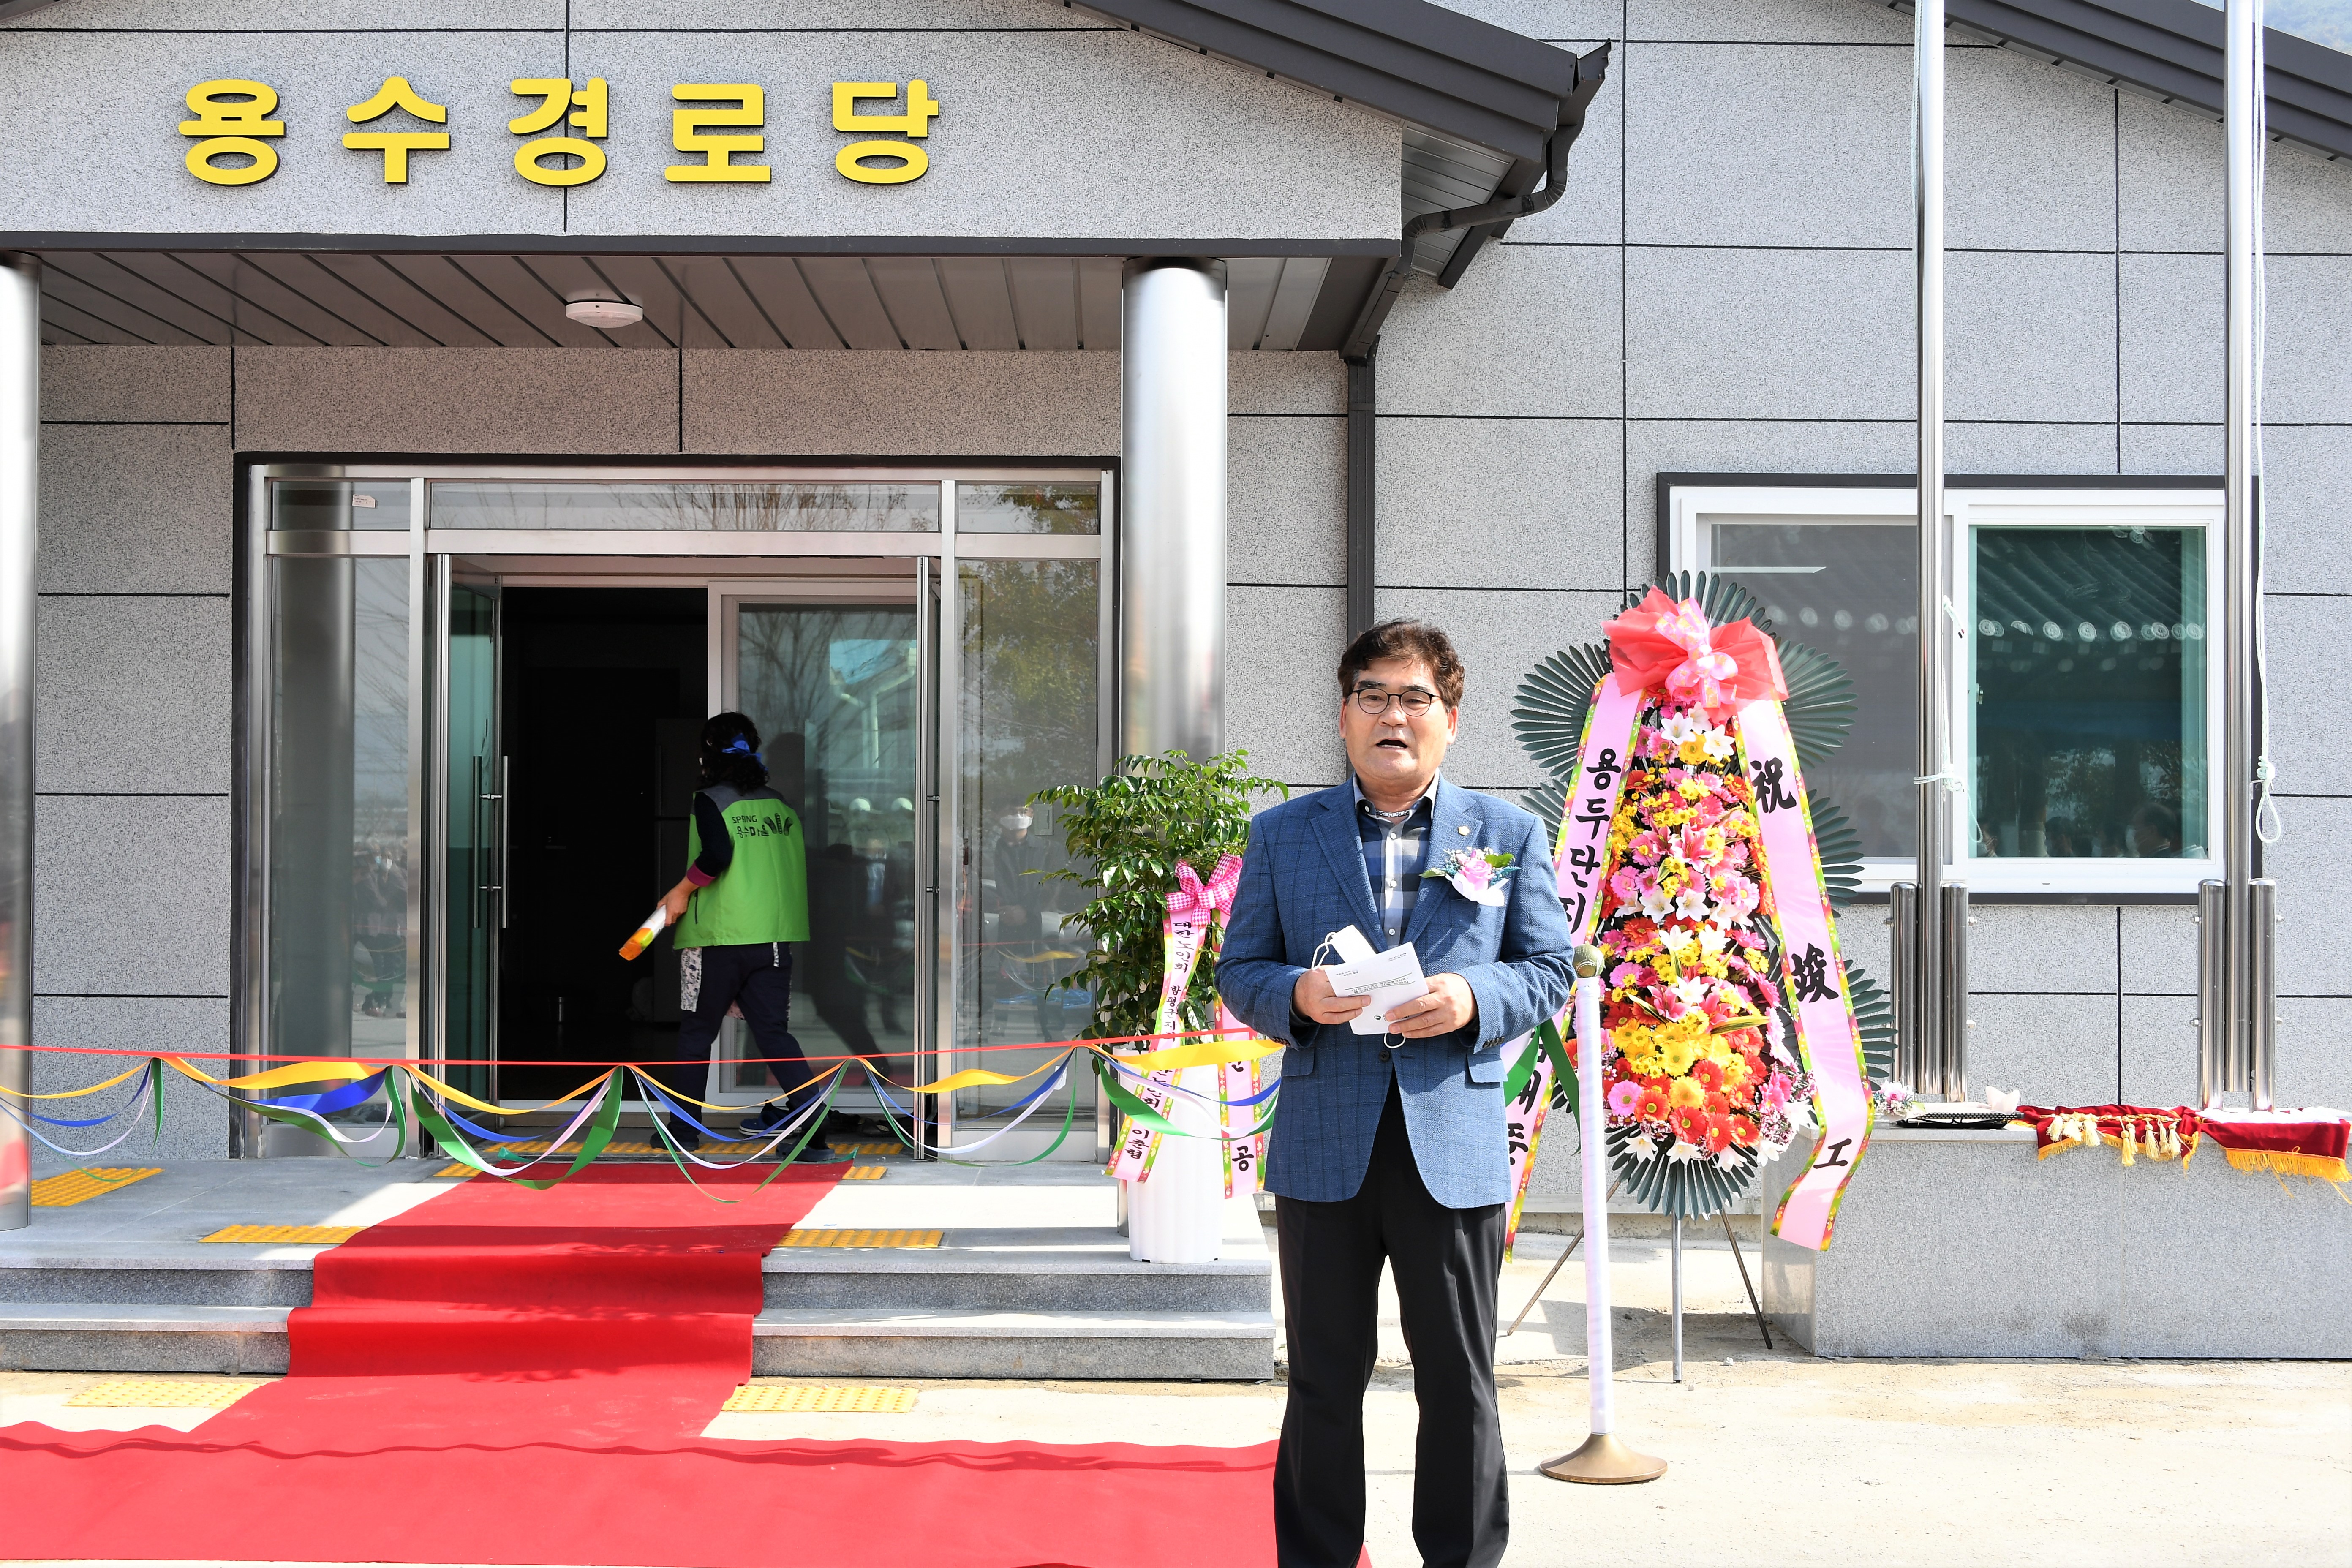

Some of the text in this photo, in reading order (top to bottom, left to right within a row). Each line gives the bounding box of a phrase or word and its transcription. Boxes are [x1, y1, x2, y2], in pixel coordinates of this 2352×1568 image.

[179, 77, 940, 187] 용수경로당
[732, 815, 758, 824] SPRING
[1172, 921, 1195, 974] 대한노인회
